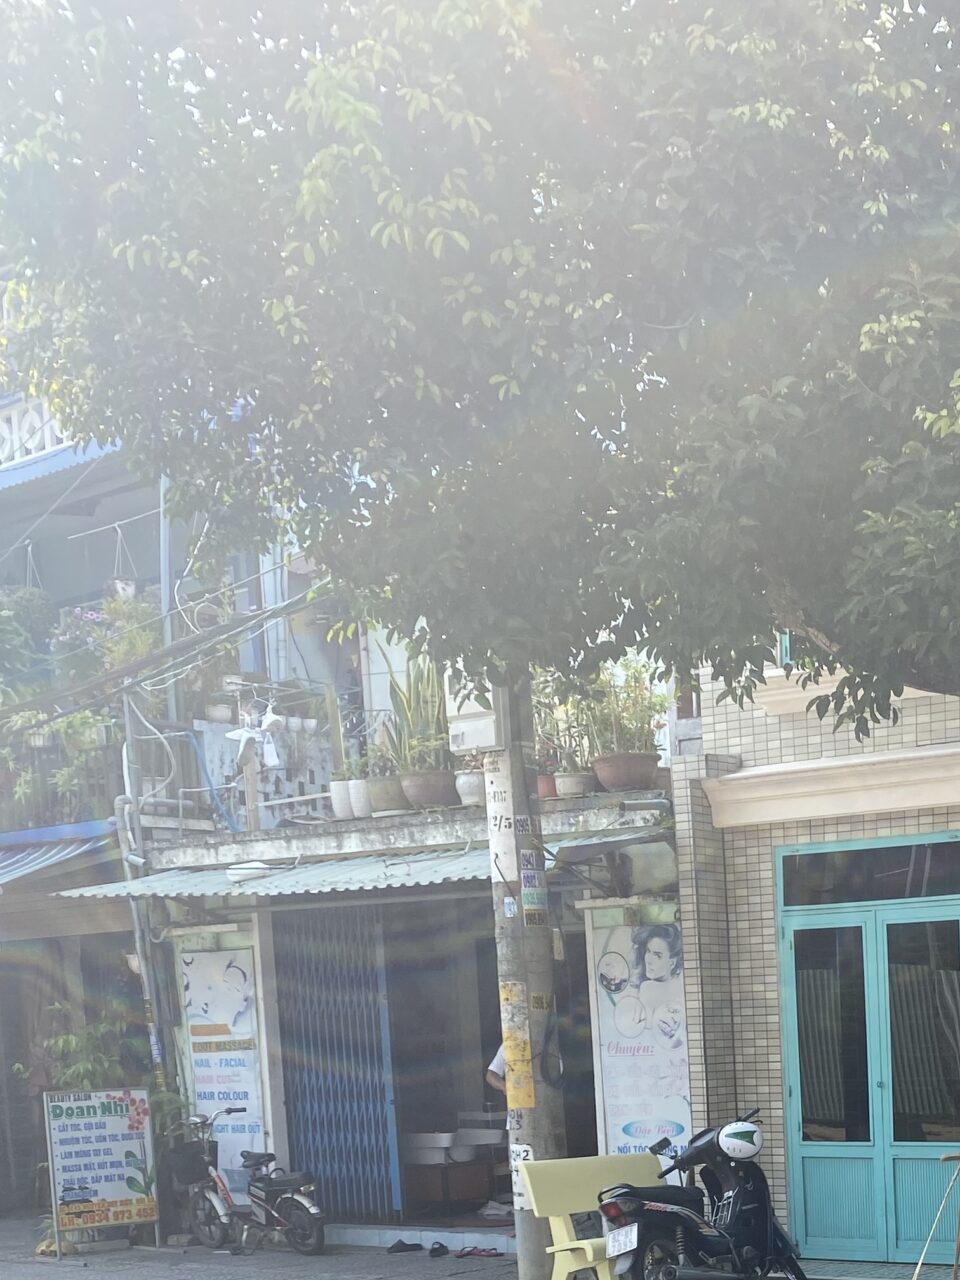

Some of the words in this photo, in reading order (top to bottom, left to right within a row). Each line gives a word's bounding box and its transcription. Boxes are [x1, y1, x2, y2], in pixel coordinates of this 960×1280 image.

[194, 1058, 211, 1068] NAIL
[219, 1058, 248, 1068] FACIAL
[197, 1091, 215, 1101] HAIR
[217, 1091, 249, 1101] COLOUR
[82, 1211, 109, 1225] 0934
[112, 1209, 132, 1221] 973
[136, 1206, 155, 1218] 452
